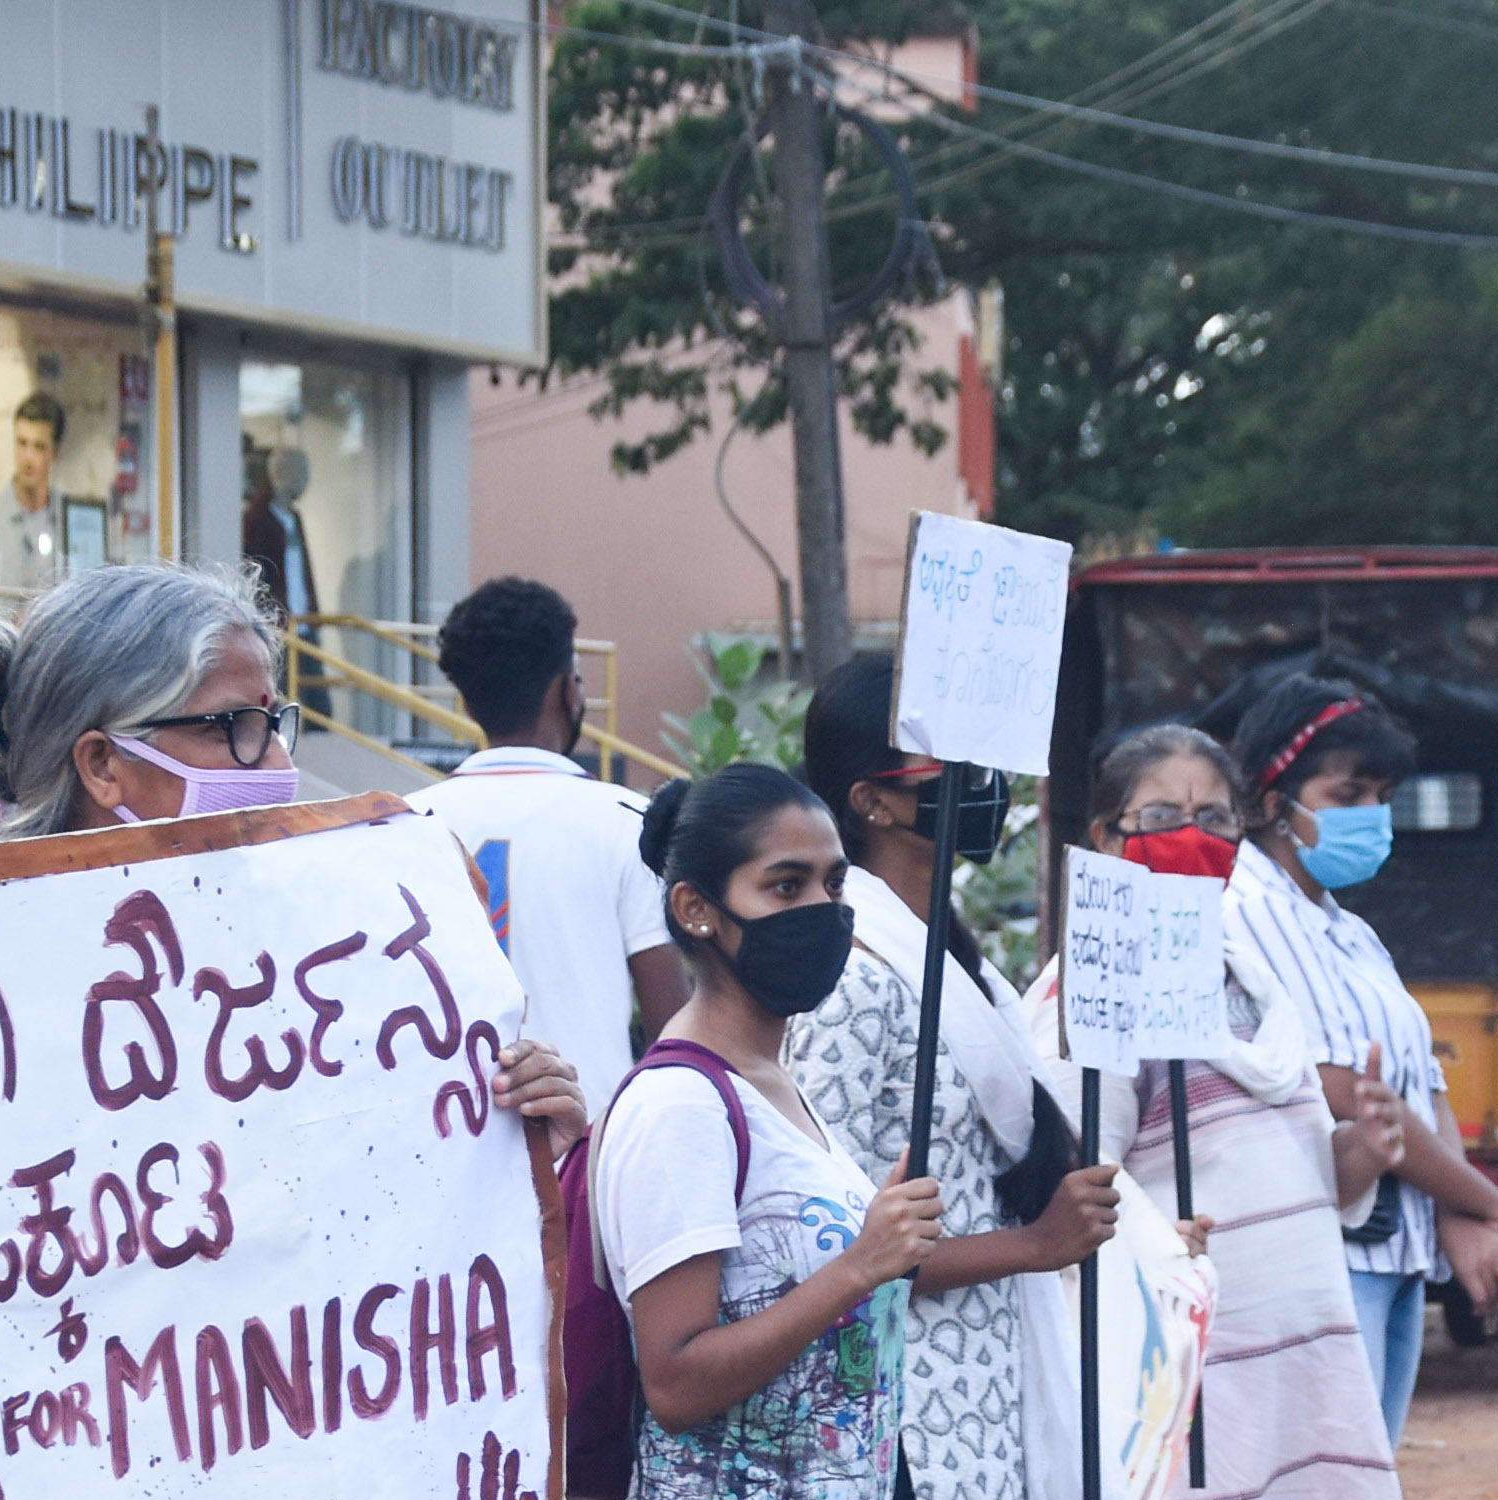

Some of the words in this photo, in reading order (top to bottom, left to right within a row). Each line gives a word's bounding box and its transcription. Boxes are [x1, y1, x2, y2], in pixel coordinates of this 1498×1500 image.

[330, 135, 514, 252] OUTLET
[2, 1381, 101, 1456] FOR
[104, 1253, 519, 1479] MANISHA
